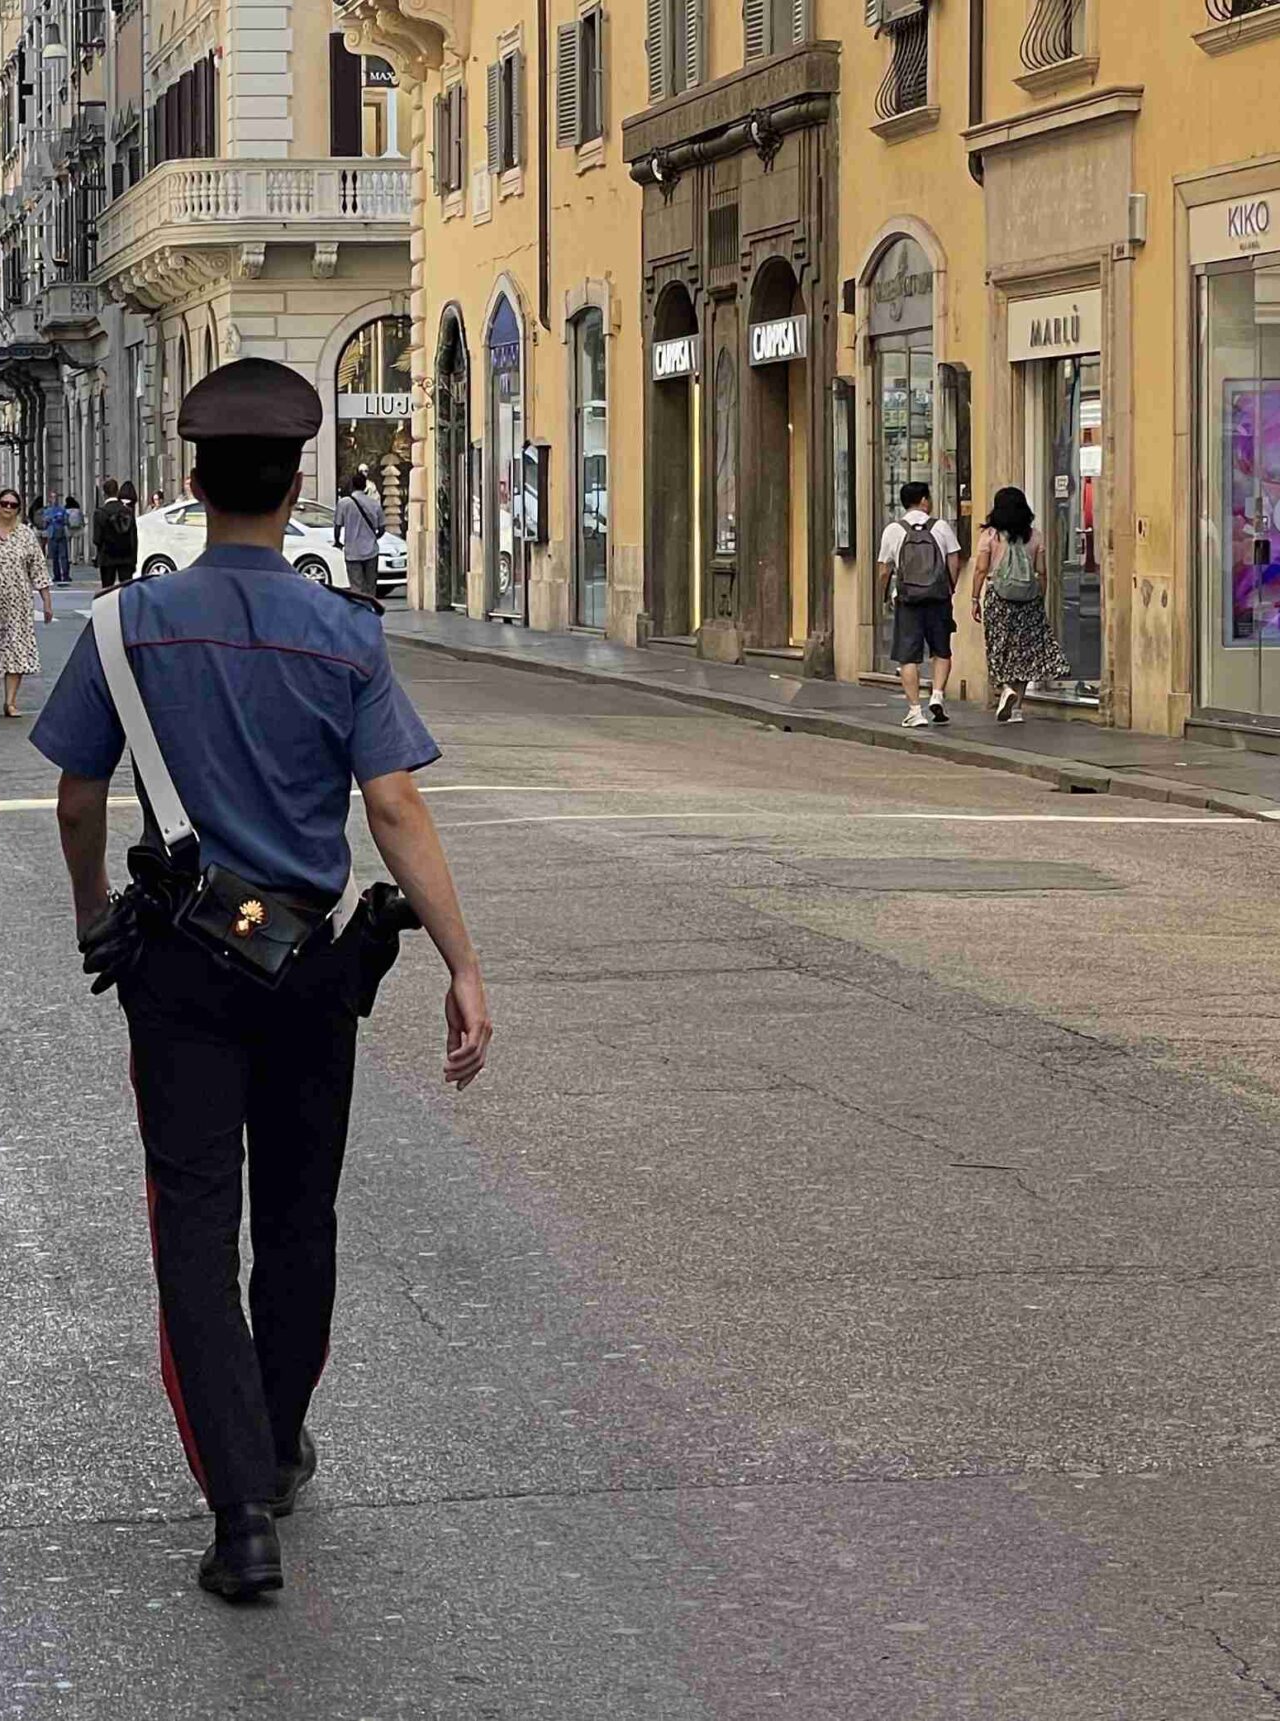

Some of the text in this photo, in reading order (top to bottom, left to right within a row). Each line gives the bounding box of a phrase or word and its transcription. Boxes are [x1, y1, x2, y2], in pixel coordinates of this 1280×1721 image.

[1228, 201, 1269, 237] KIKO
[753, 321, 796, 361] CARPISA
[1030, 304, 1080, 347] MARLÙ
[655, 340, 691, 376] CARPISA
[365, 396, 415, 415] LIU·J
